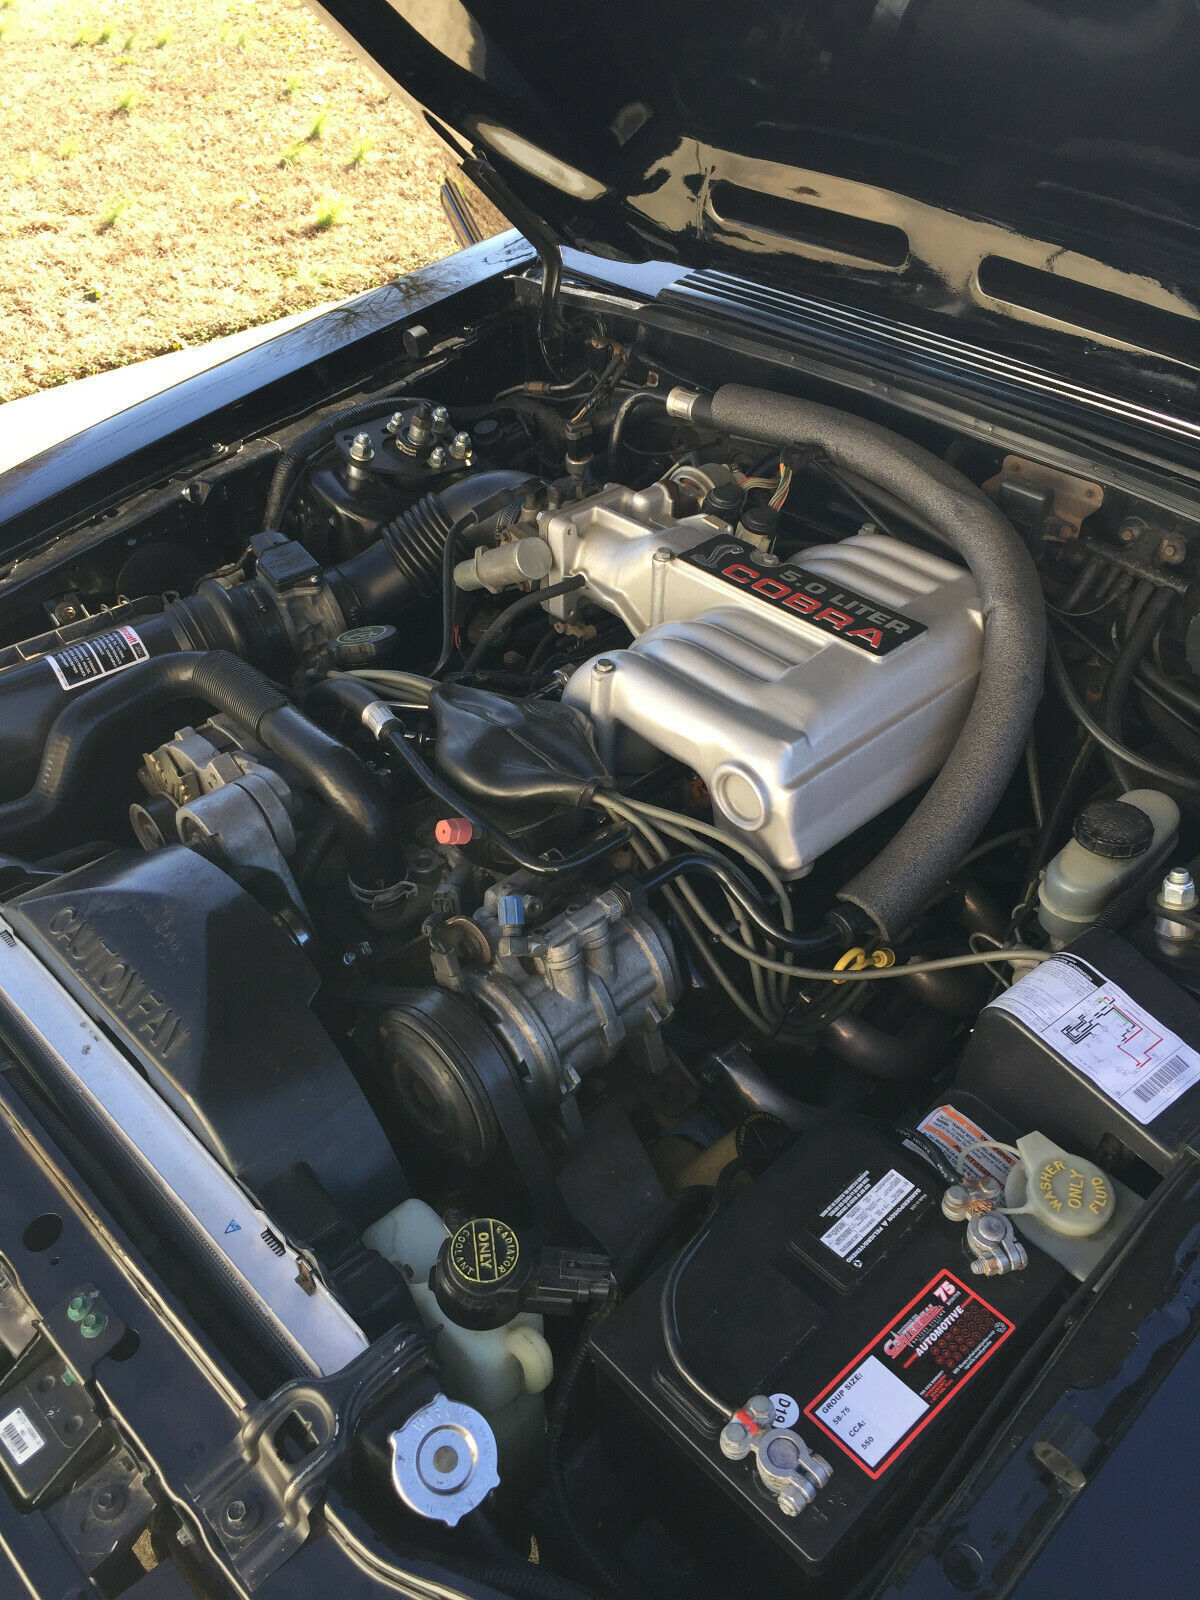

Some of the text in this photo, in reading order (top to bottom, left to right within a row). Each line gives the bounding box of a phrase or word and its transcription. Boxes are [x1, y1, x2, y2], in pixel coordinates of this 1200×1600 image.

[722, 564, 883, 649] COBRA
[780, 570, 911, 636] 5.0 LITER
[50, 907, 191, 1059] CAUTION FAN
[1040, 1160, 1066, 1211] WASHER
[1068, 1169, 1084, 1208] ONLY
[1089, 1177, 1107, 1214] FLUID
[455, 1230, 475, 1275] COOLANT
[478, 1232, 492, 1269] ONLY
[496, 1226, 515, 1273] RADIATOR
[932, 1280, 956, 1303] 75
[915, 1305, 965, 1357] AUTOMOTIVE
[775, 1398, 791, 1423] D19
[822, 1372, 863, 1414] GROUP SIZE:
[832, 1406, 851, 1425] 58-75
[848, 1420, 866, 1438] CCA:
[861, 1436, 874, 1450] 550
